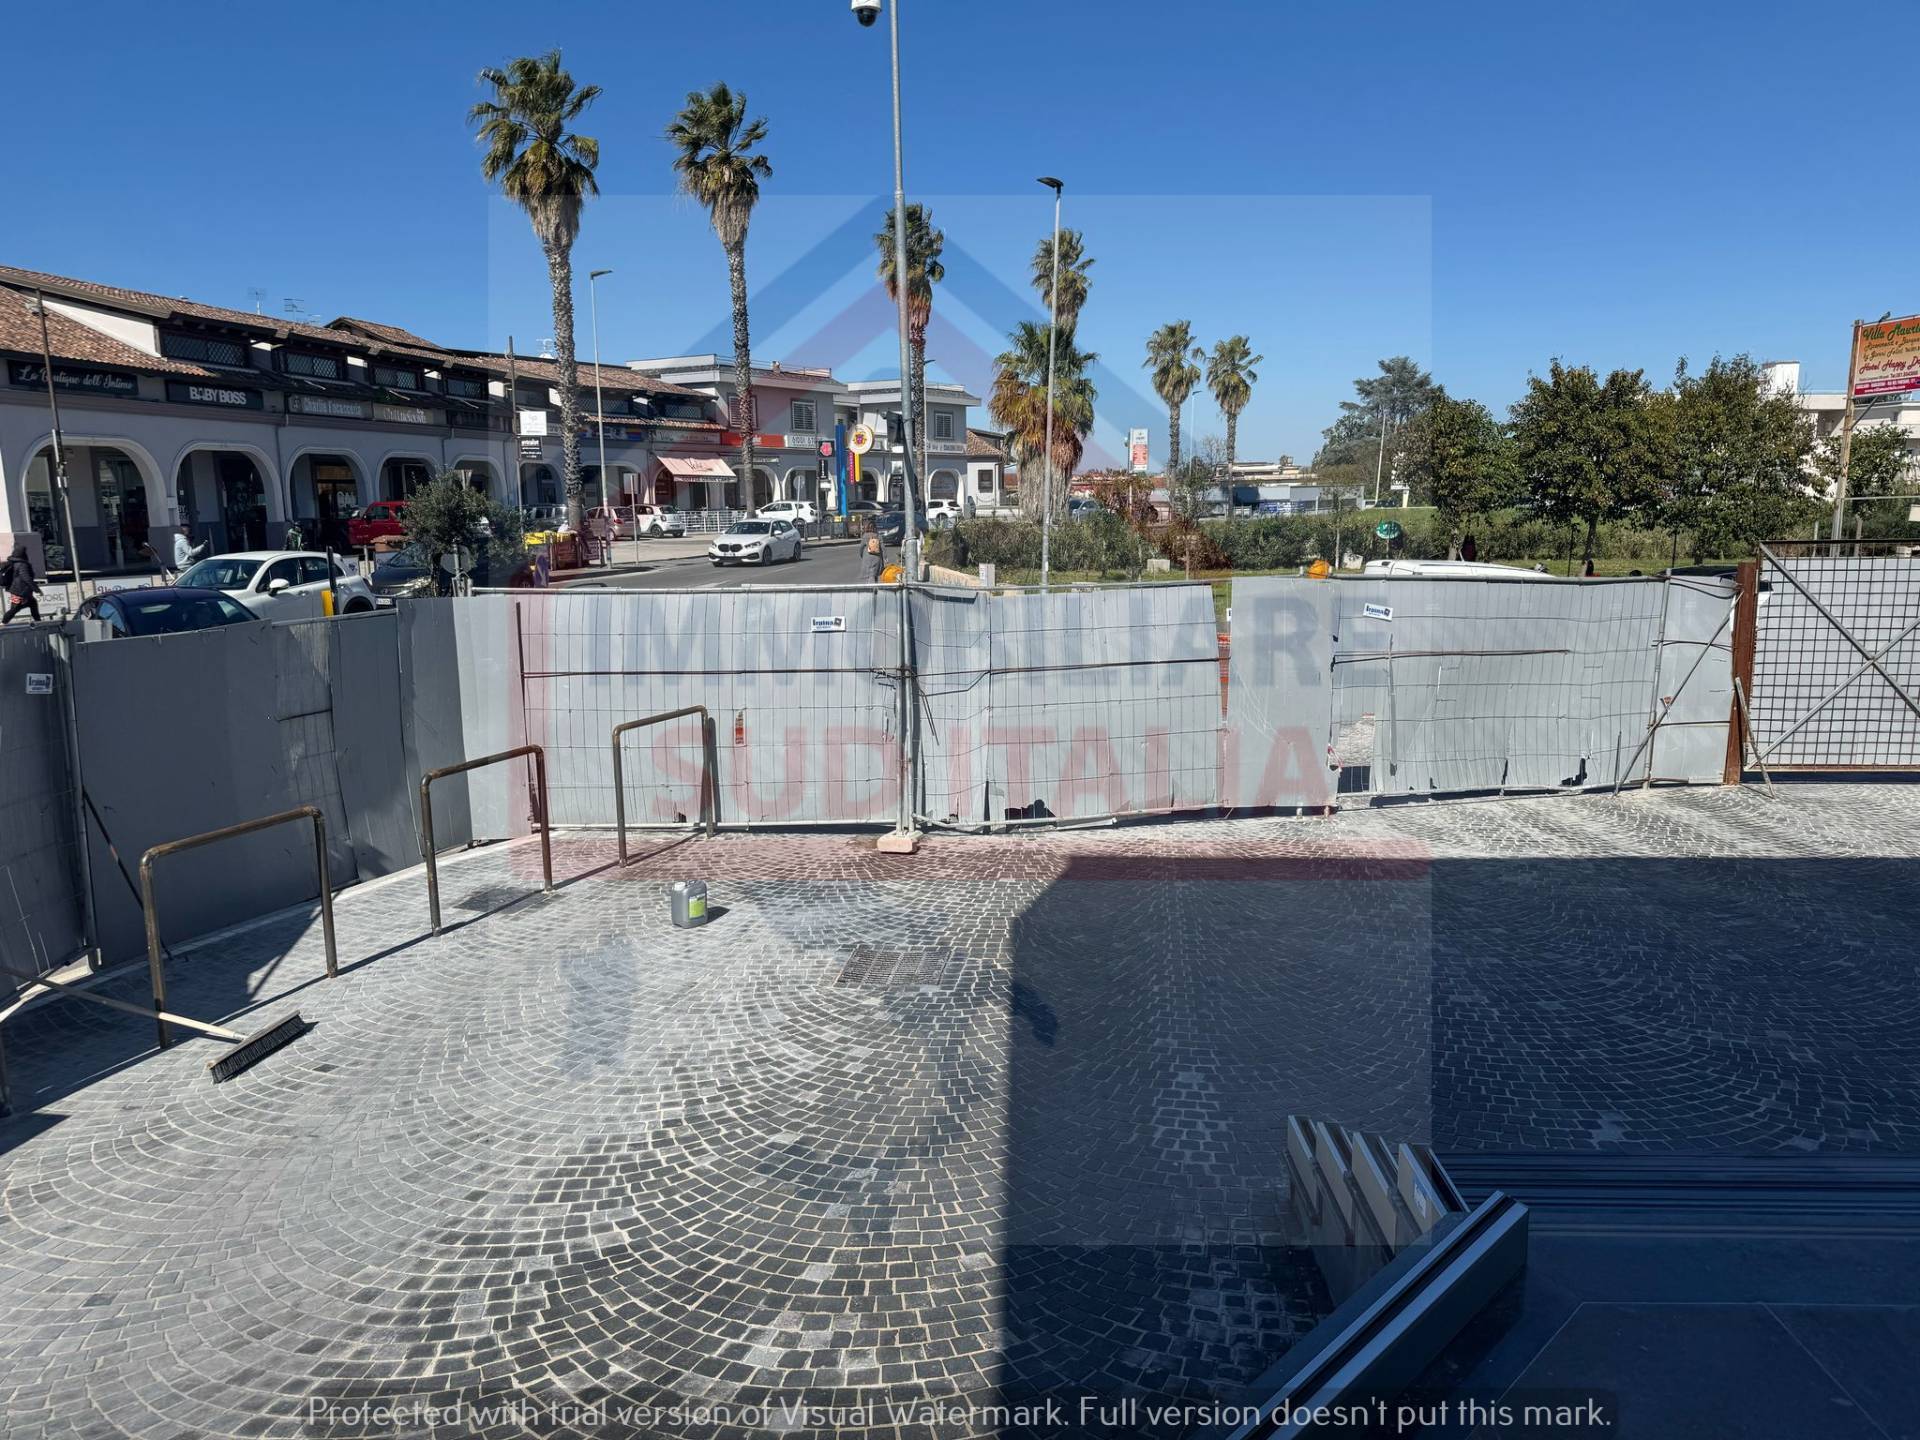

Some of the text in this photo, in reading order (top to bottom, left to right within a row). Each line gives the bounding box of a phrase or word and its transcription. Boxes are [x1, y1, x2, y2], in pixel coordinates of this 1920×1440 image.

[1859, 361, 1881, 374] Hotel
[1882, 358, 1907, 372] Happy
[189, 386, 247, 405] BABY BOSS
